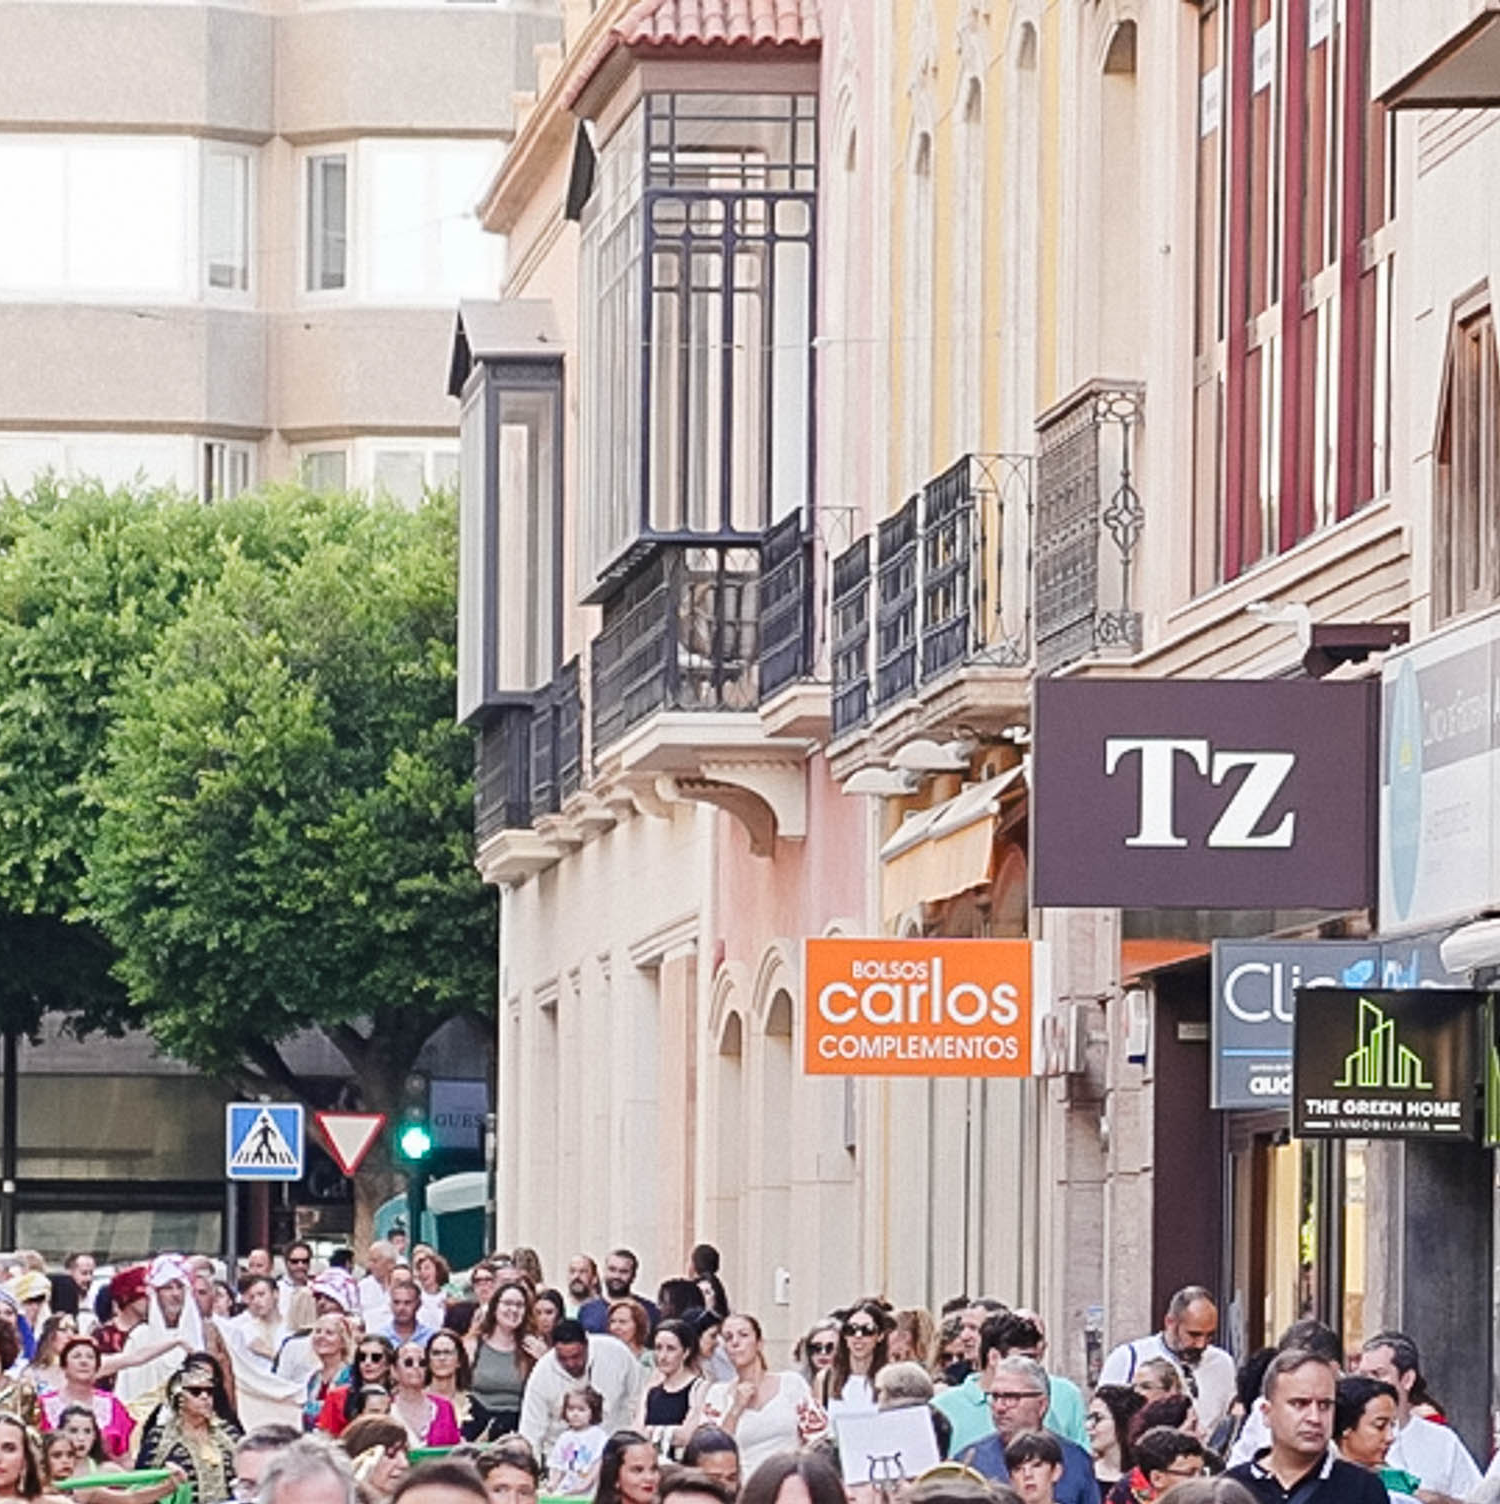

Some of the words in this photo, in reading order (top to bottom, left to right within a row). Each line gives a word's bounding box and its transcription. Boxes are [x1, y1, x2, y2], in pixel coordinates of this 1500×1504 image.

[852, 961, 929, 980] BOLSOS
[818, 957, 1019, 1026] carlos
[818, 1034, 1019, 1060] COMPLEMENTOS
[1306, 1099, 1339, 1115] THE
[1343, 1099, 1402, 1116] GREEN
[1406, 1101, 1461, 1117] HOME
